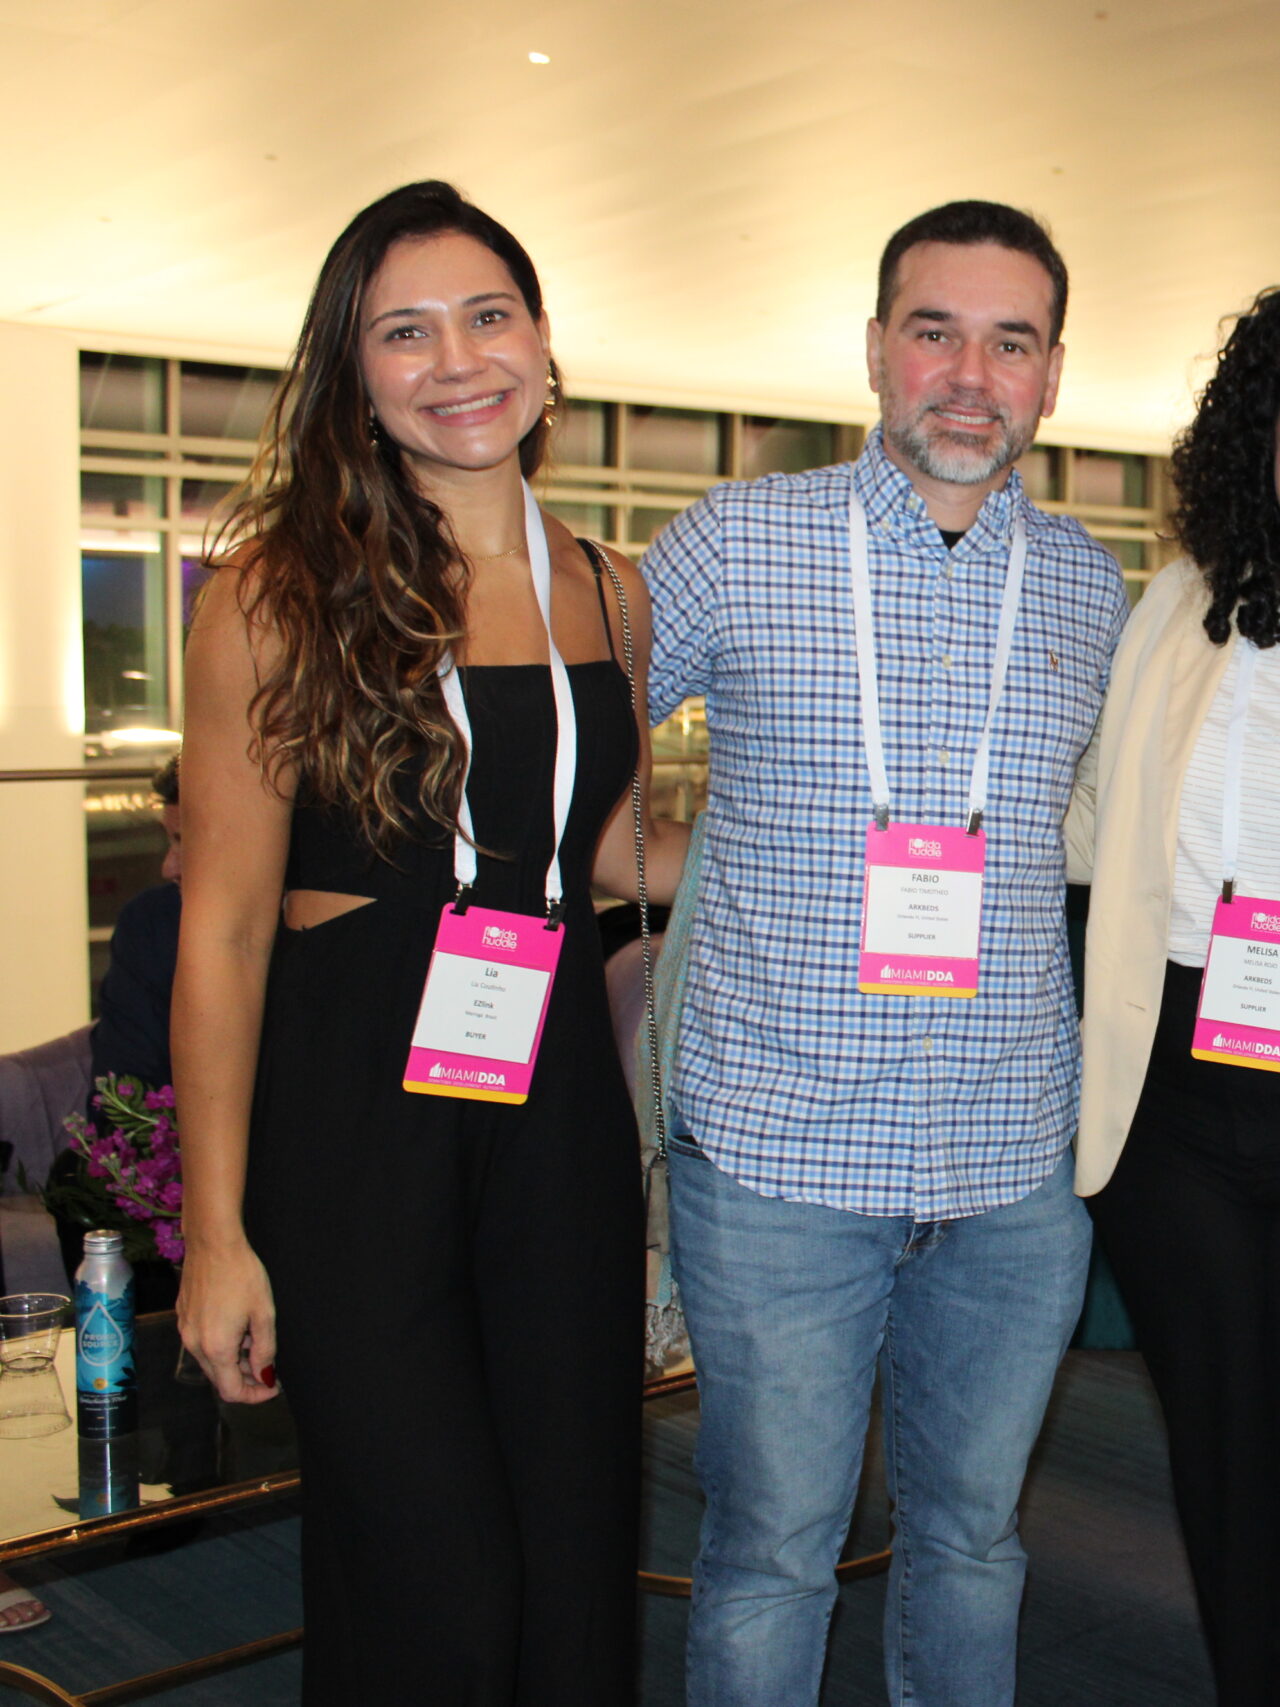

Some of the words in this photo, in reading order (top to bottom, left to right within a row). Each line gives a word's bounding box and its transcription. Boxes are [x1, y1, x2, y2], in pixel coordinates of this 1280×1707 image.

[908, 847, 942, 857] huddle
[911, 873, 940, 883] FABIO
[908, 903, 940, 912] ARKBEDS
[907, 932, 937, 941] SUPPLIER
[481, 935, 518, 950] huddle
[1246, 945, 1279, 957] MELISA
[1243, 958, 1263, 967] MELISA
[484, 966, 499, 979] Lia
[1243, 975, 1273, 985] ARKBEDS
[1240, 1003, 1267, 1013] SUPPLIER
[464, 1030, 487, 1042] BUYER
